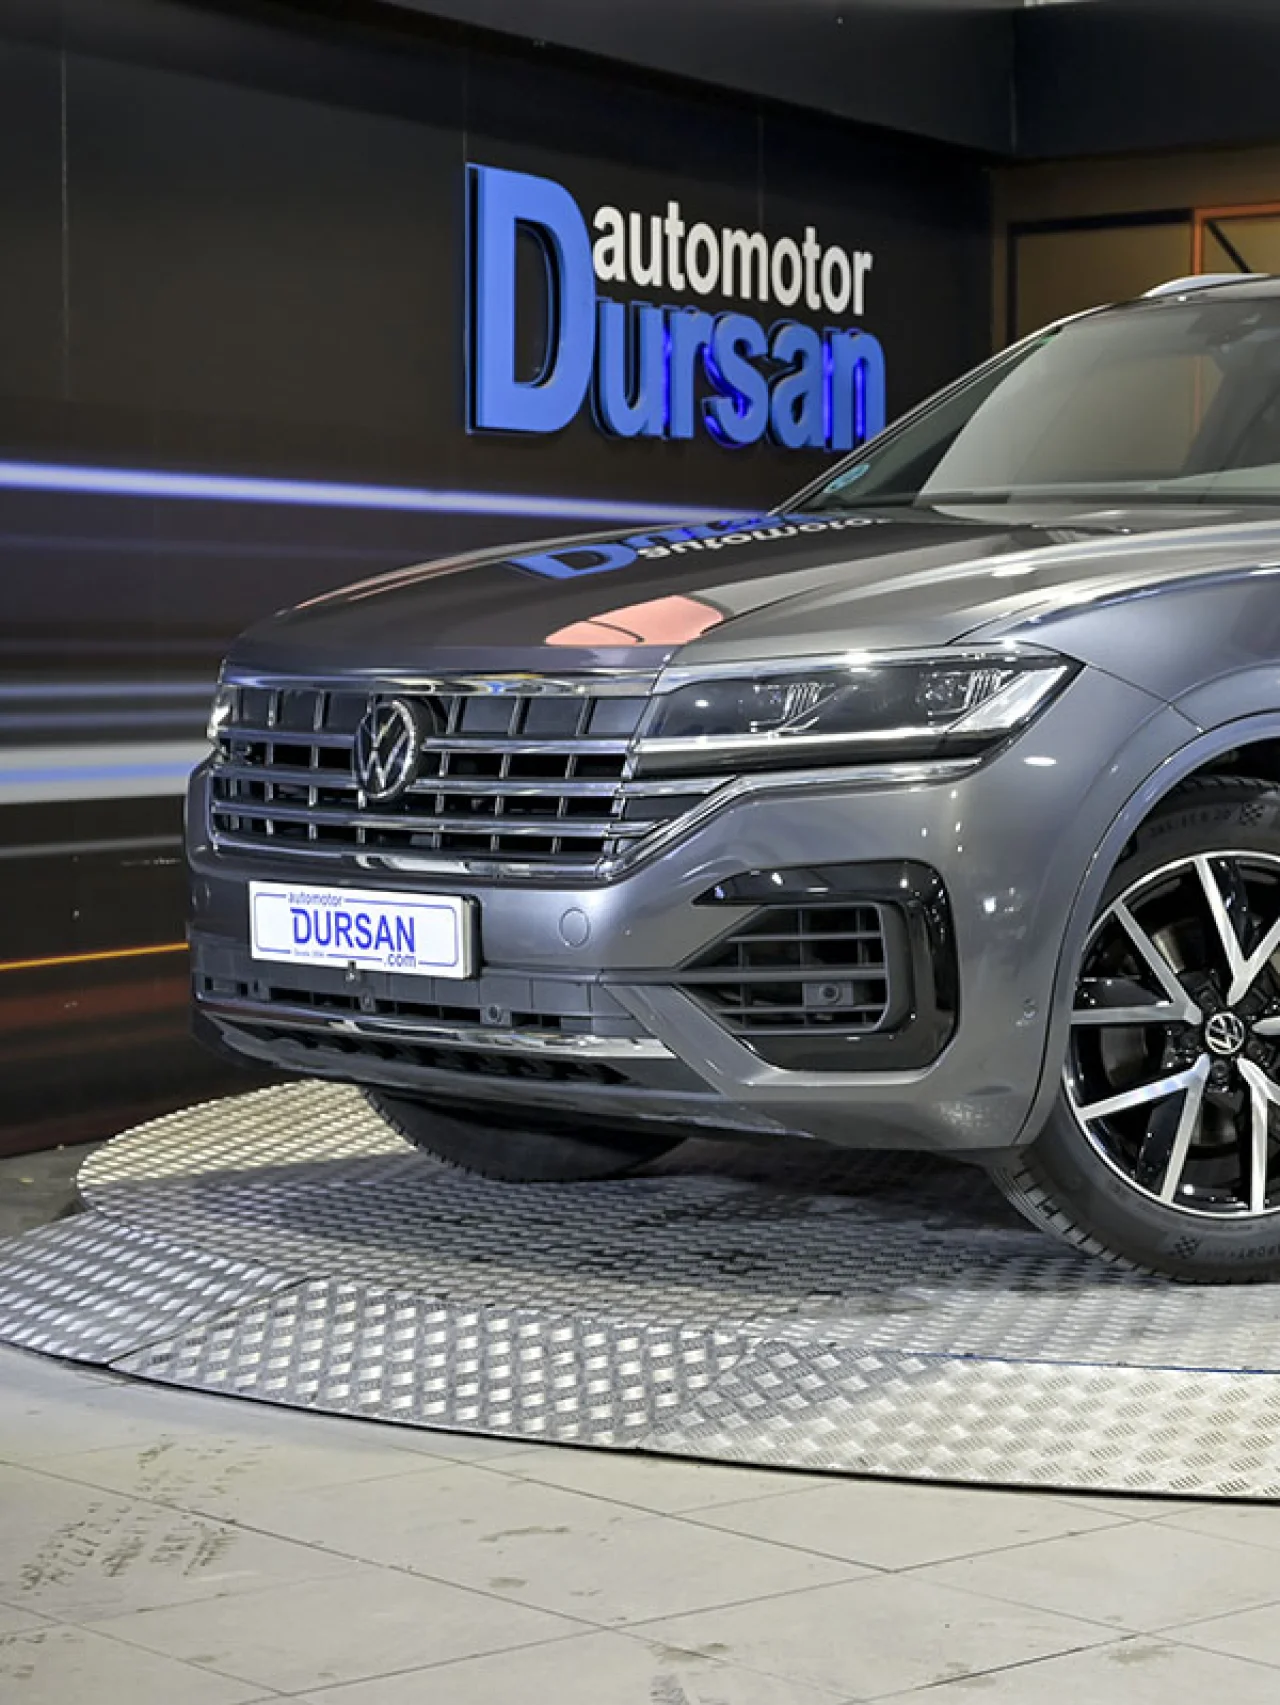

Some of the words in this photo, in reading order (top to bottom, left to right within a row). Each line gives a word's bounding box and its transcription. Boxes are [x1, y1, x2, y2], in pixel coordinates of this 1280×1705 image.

[593, 201, 873, 315] automotor
[466, 162, 887, 451] Dursan
[288, 891, 342, 907] automotor
[289, 907, 416, 953] DURSAN
